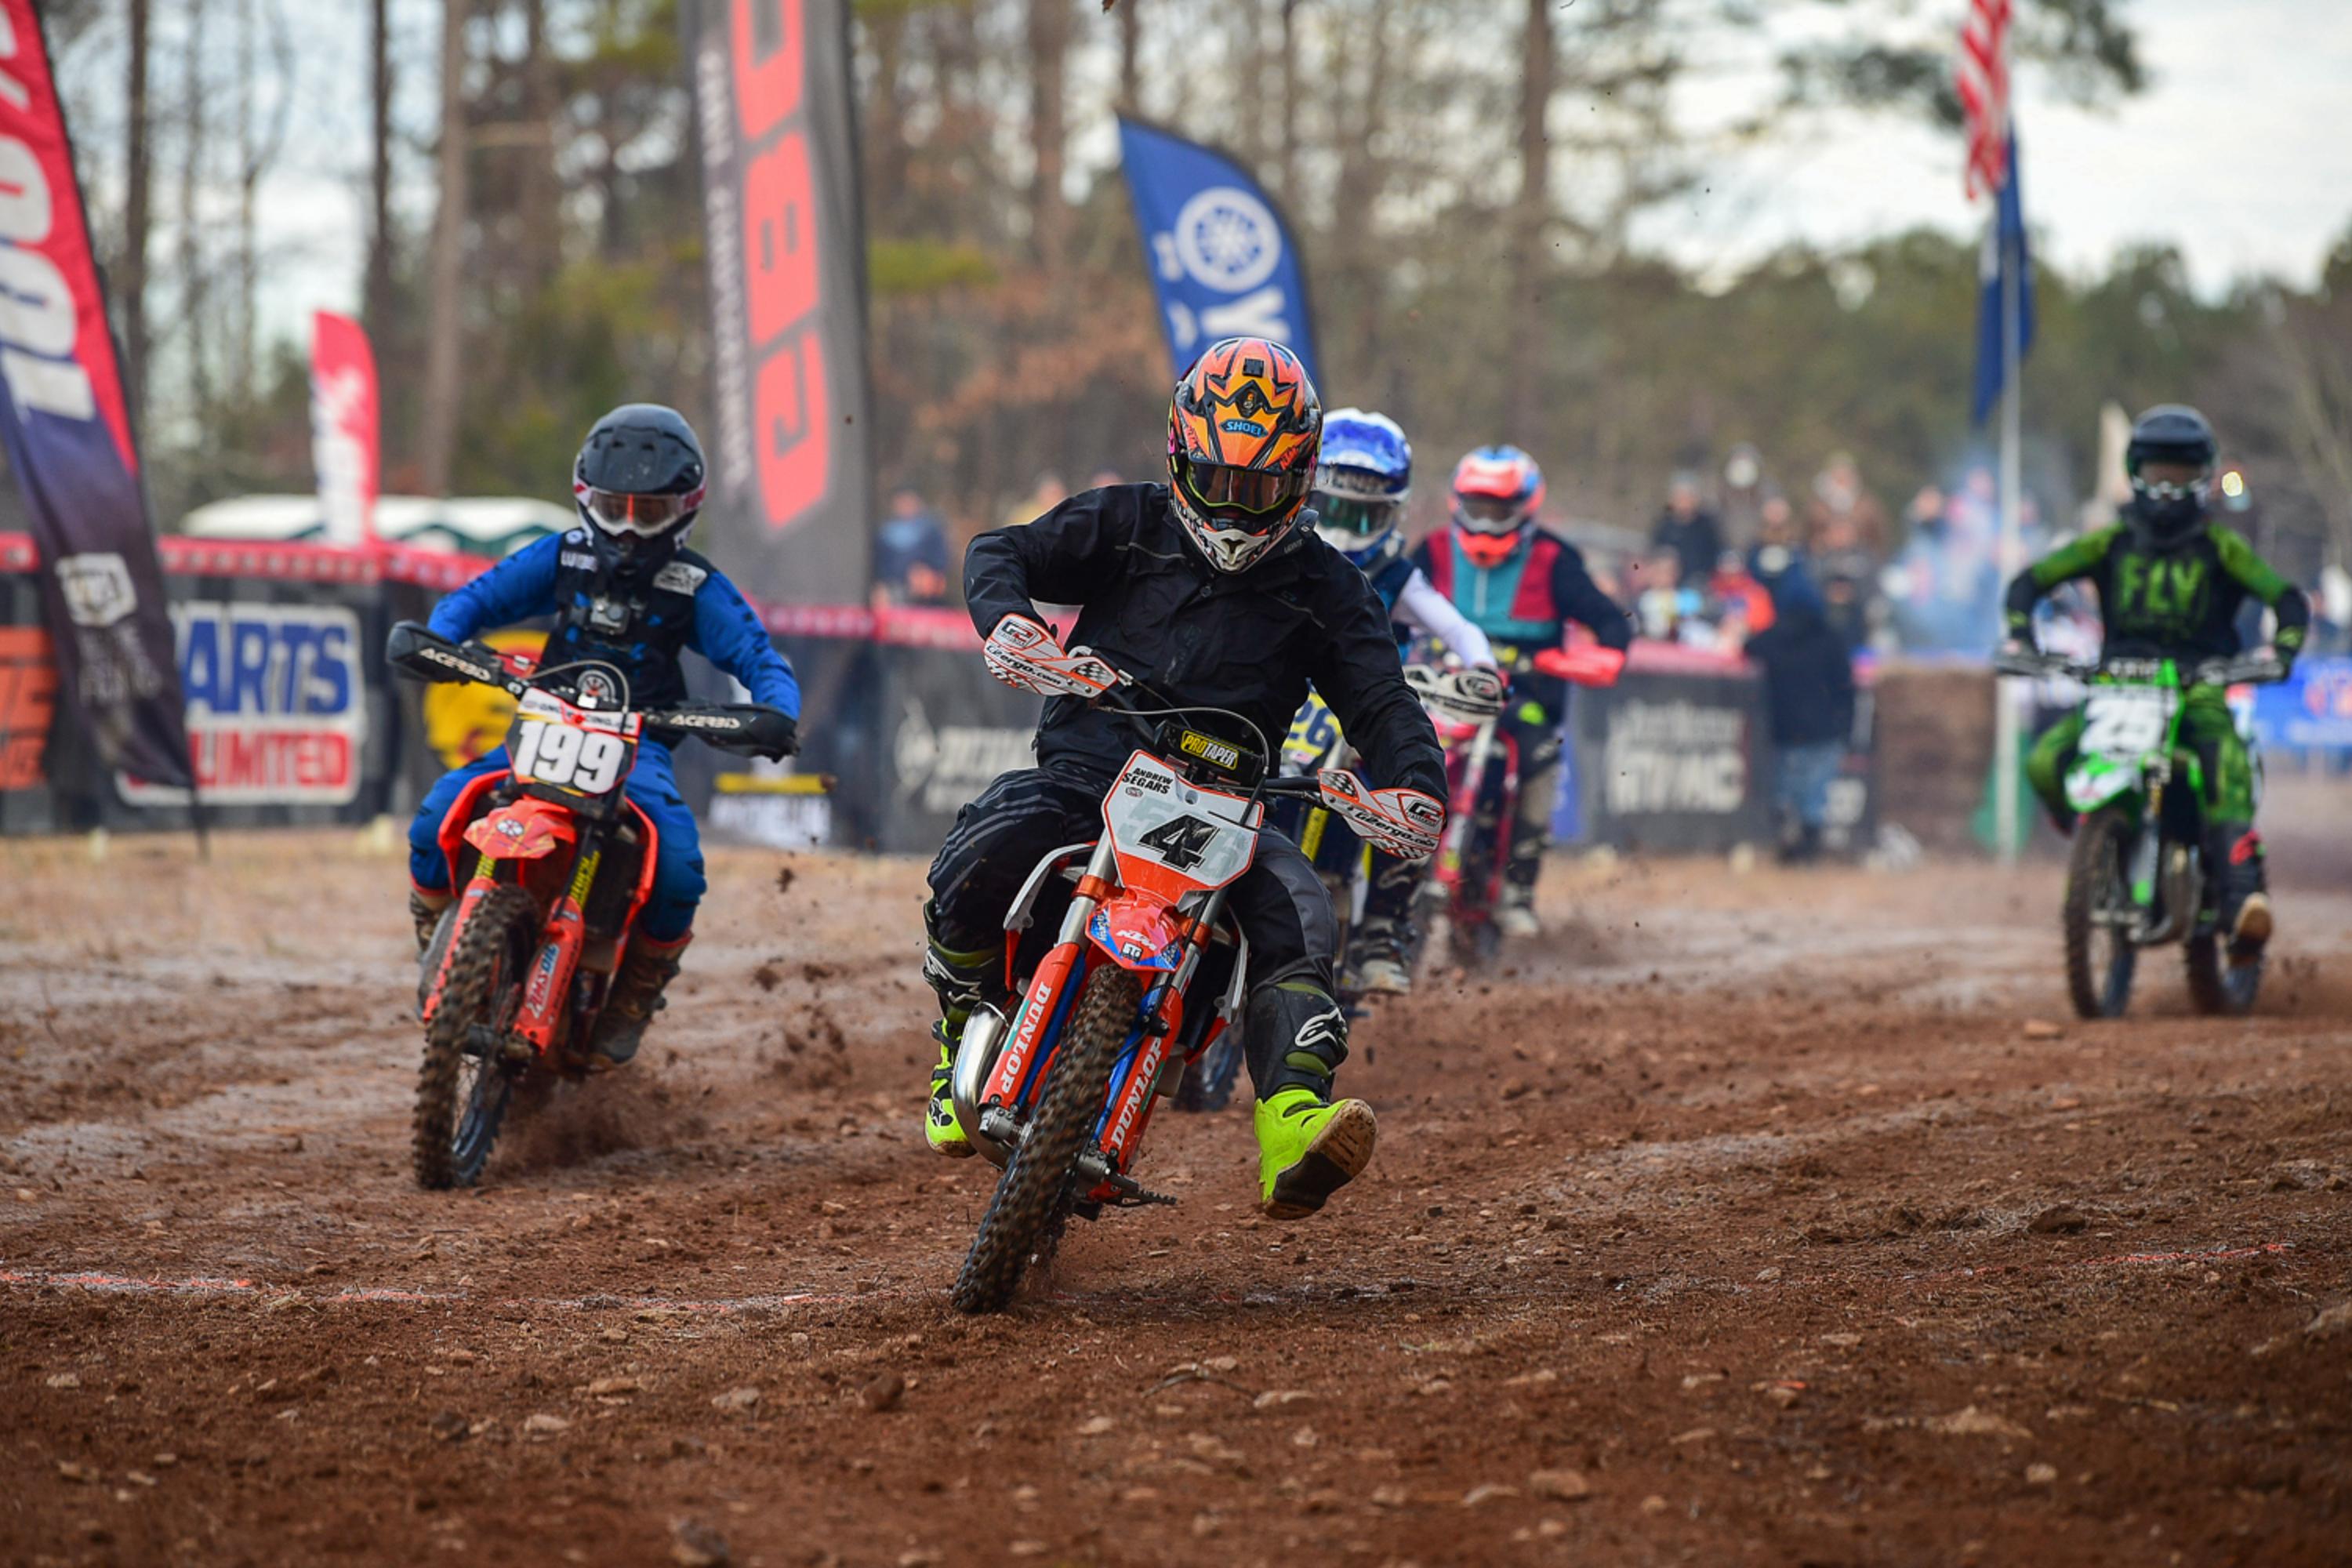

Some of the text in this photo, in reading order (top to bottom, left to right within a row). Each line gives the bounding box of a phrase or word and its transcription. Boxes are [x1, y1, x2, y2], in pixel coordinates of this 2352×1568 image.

[1225, 419, 1263, 437] SHOEI
[2119, 553, 2205, 615] FLY
[180, 620, 351, 715] ARTS
[418, 648, 492, 681] ACERBIS
[669, 713, 742, 729] ACERBIS
[514, 720, 626, 794] 199
[1122, 773, 1171, 794] SEGARS
[1133, 768, 1174, 785] ANDREW
[1137, 814, 1221, 873] 4
[1000, 981, 1052, 1094] DUNLOP
[1111, 1036, 1163, 1149] DUNLOP
